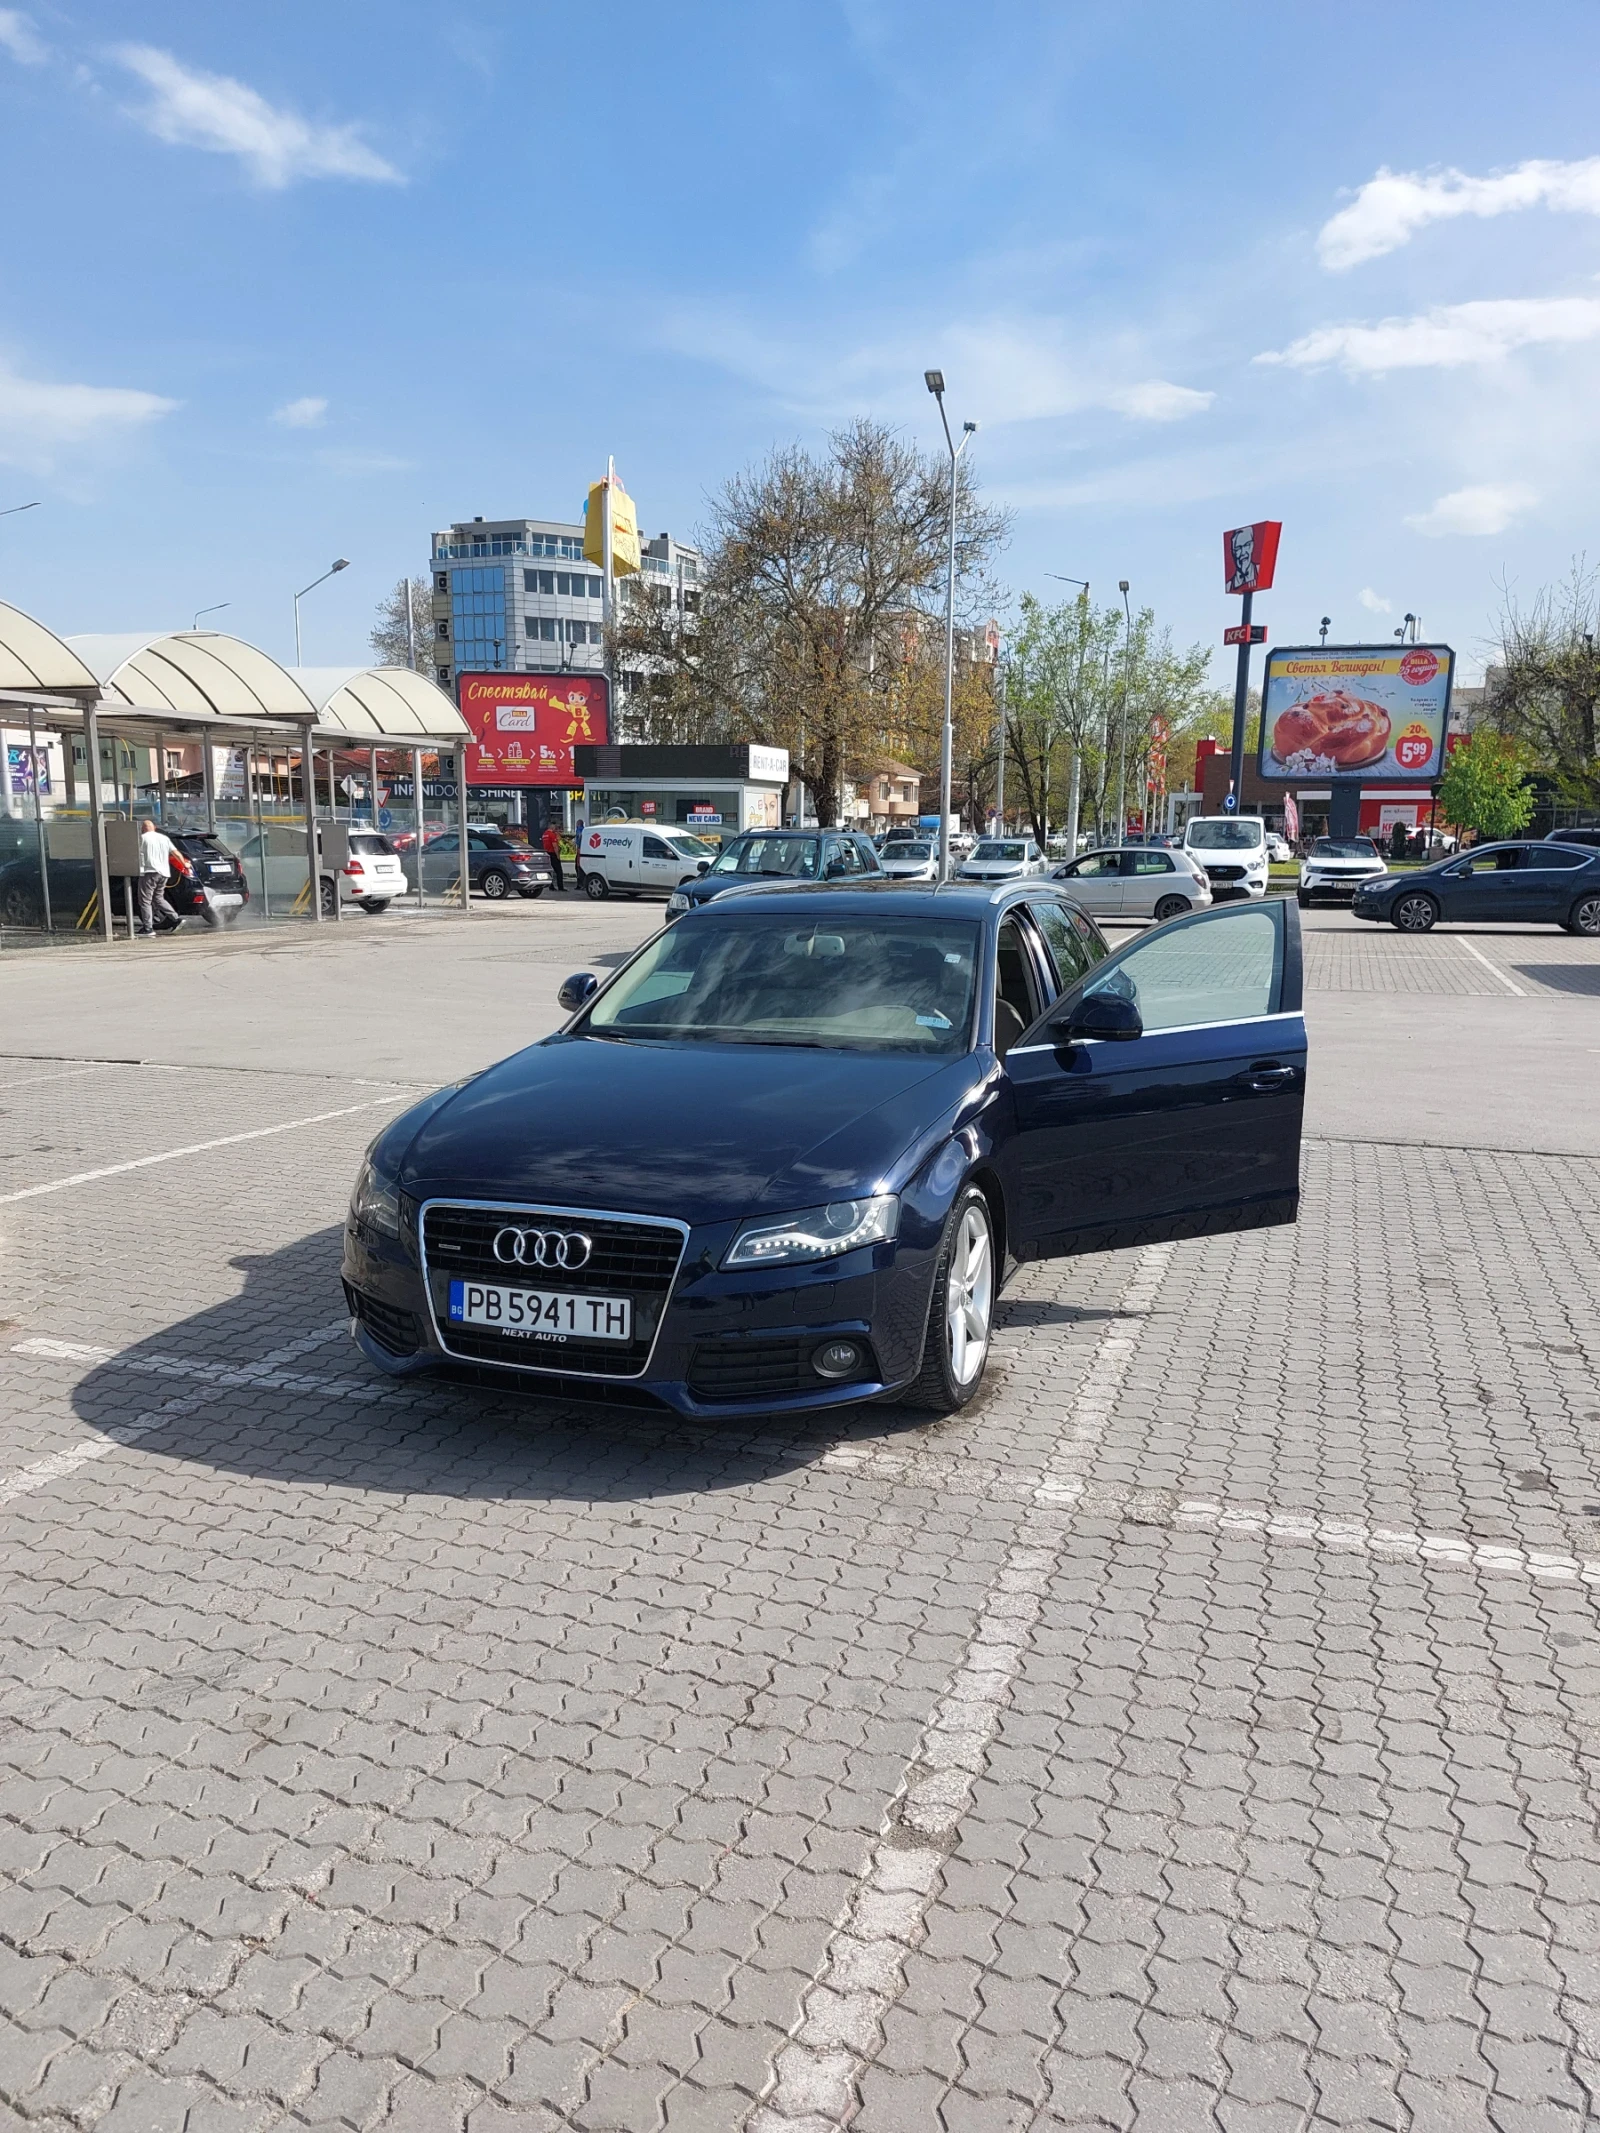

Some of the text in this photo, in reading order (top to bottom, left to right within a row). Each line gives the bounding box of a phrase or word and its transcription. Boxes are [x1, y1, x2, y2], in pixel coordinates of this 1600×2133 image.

[1226, 629, 1246, 642] KFC
[1286, 660, 1385, 677] Светъл Великден!
[1396, 664, 1411, 676] 25
[468, 682, 548, 700] Спестявай
[500, 713, 531, 727] Card
[1406, 724, 1427, 734] -20%
[540, 745, 556, 758] 5%
[602, 836, 633, 848] speedy
[452, 1287, 625, 1336] BG PB 5941 TH
[502, 1328, 567, 1343] NEXT AUTO
